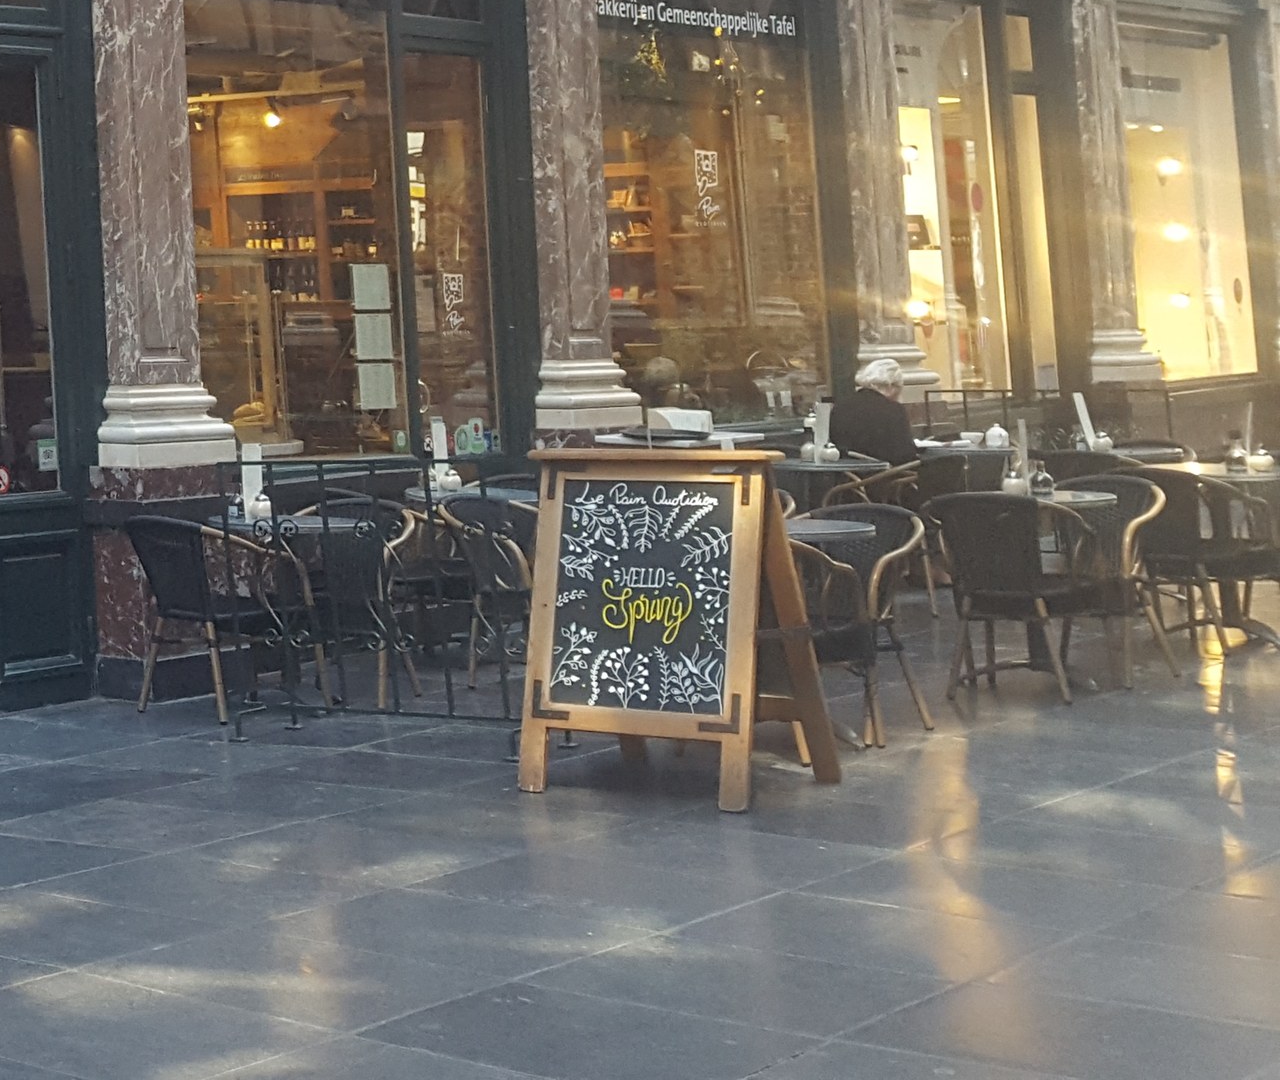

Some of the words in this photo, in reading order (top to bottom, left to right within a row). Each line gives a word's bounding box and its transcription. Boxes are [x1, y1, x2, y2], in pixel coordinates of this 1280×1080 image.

[640, 4, 655, 21] en
[656, 2, 769, 39] Gemeenschappelijke
[770, 14, 796, 37] Tafel
[575, 482, 605, 504] Le
[609, 483, 647, 505] Pain
[652, 485, 719, 506] Quotidien
[620, 567, 666, 588] HELLO
[601, 579, 693, 644] Spring
